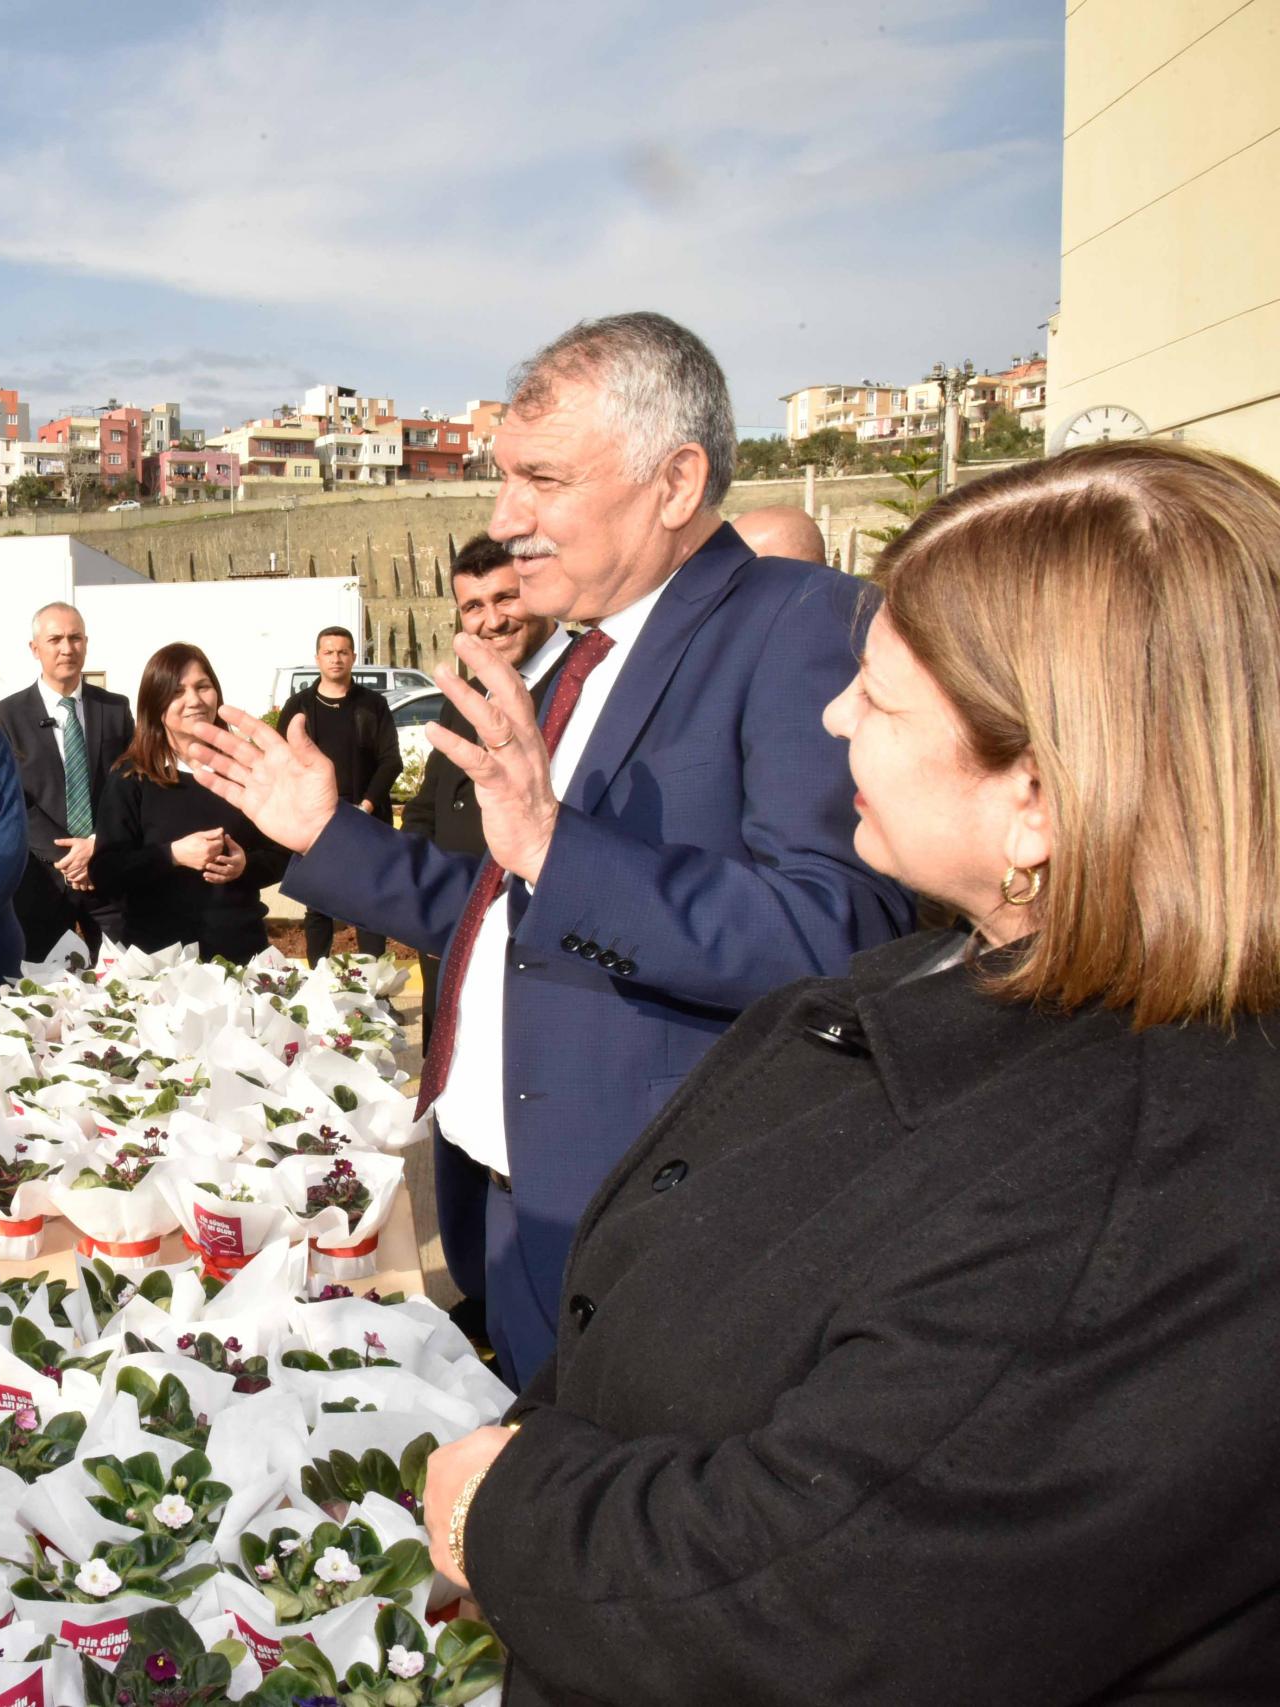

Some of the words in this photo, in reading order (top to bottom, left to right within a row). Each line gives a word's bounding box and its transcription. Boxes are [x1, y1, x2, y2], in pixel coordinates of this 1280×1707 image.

[1, 1392, 16, 1401] BİR
[78, 1636, 98, 1647] BİR
[100, 1629, 131, 1647] GÜNÜ
[96, 1647, 111, 1656] MI
